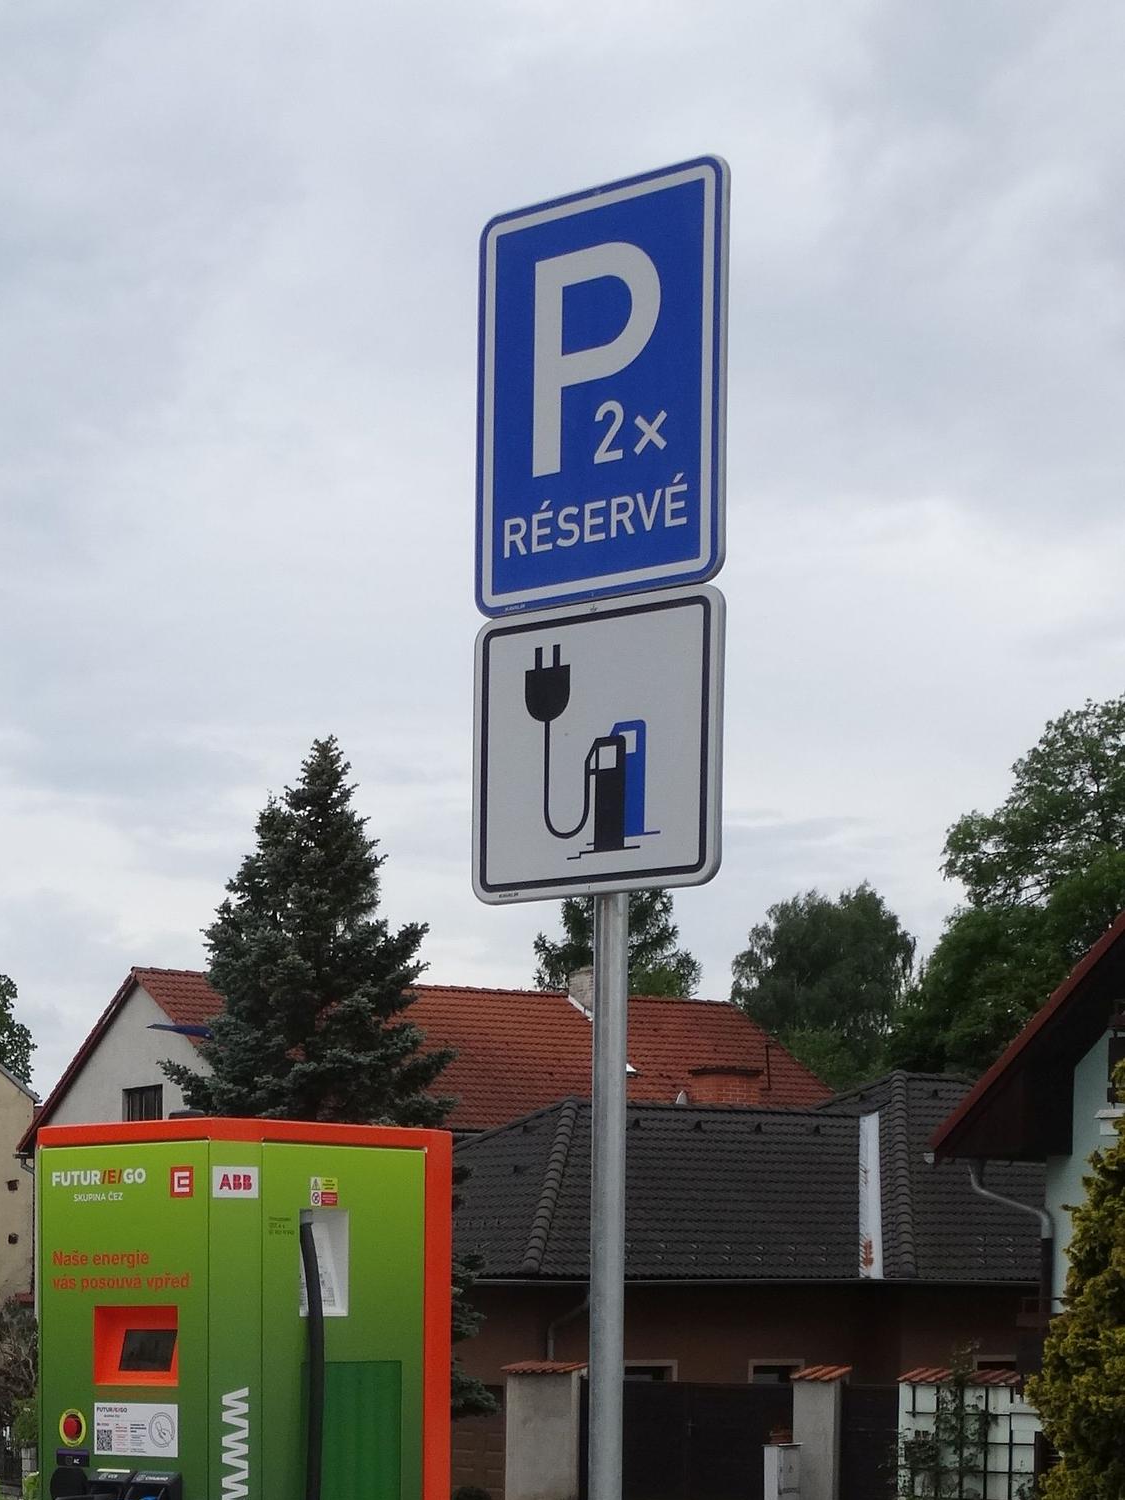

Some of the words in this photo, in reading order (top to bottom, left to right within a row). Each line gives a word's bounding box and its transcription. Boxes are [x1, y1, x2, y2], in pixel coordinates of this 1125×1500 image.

[532, 242, 661, 477] P
[504, 473, 687, 558] RÉSERVÉ
[219, 1174, 252, 1190] ABB
[73, 1193, 106, 1202] SKUPINA
[108, 1191, 123, 1201] ČEZ
[53, 1249, 88, 1266] Naše
[92, 1249, 150, 1269] energie
[52, 1274, 76, 1290] vás
[146, 1272, 189, 1292] vpřed
